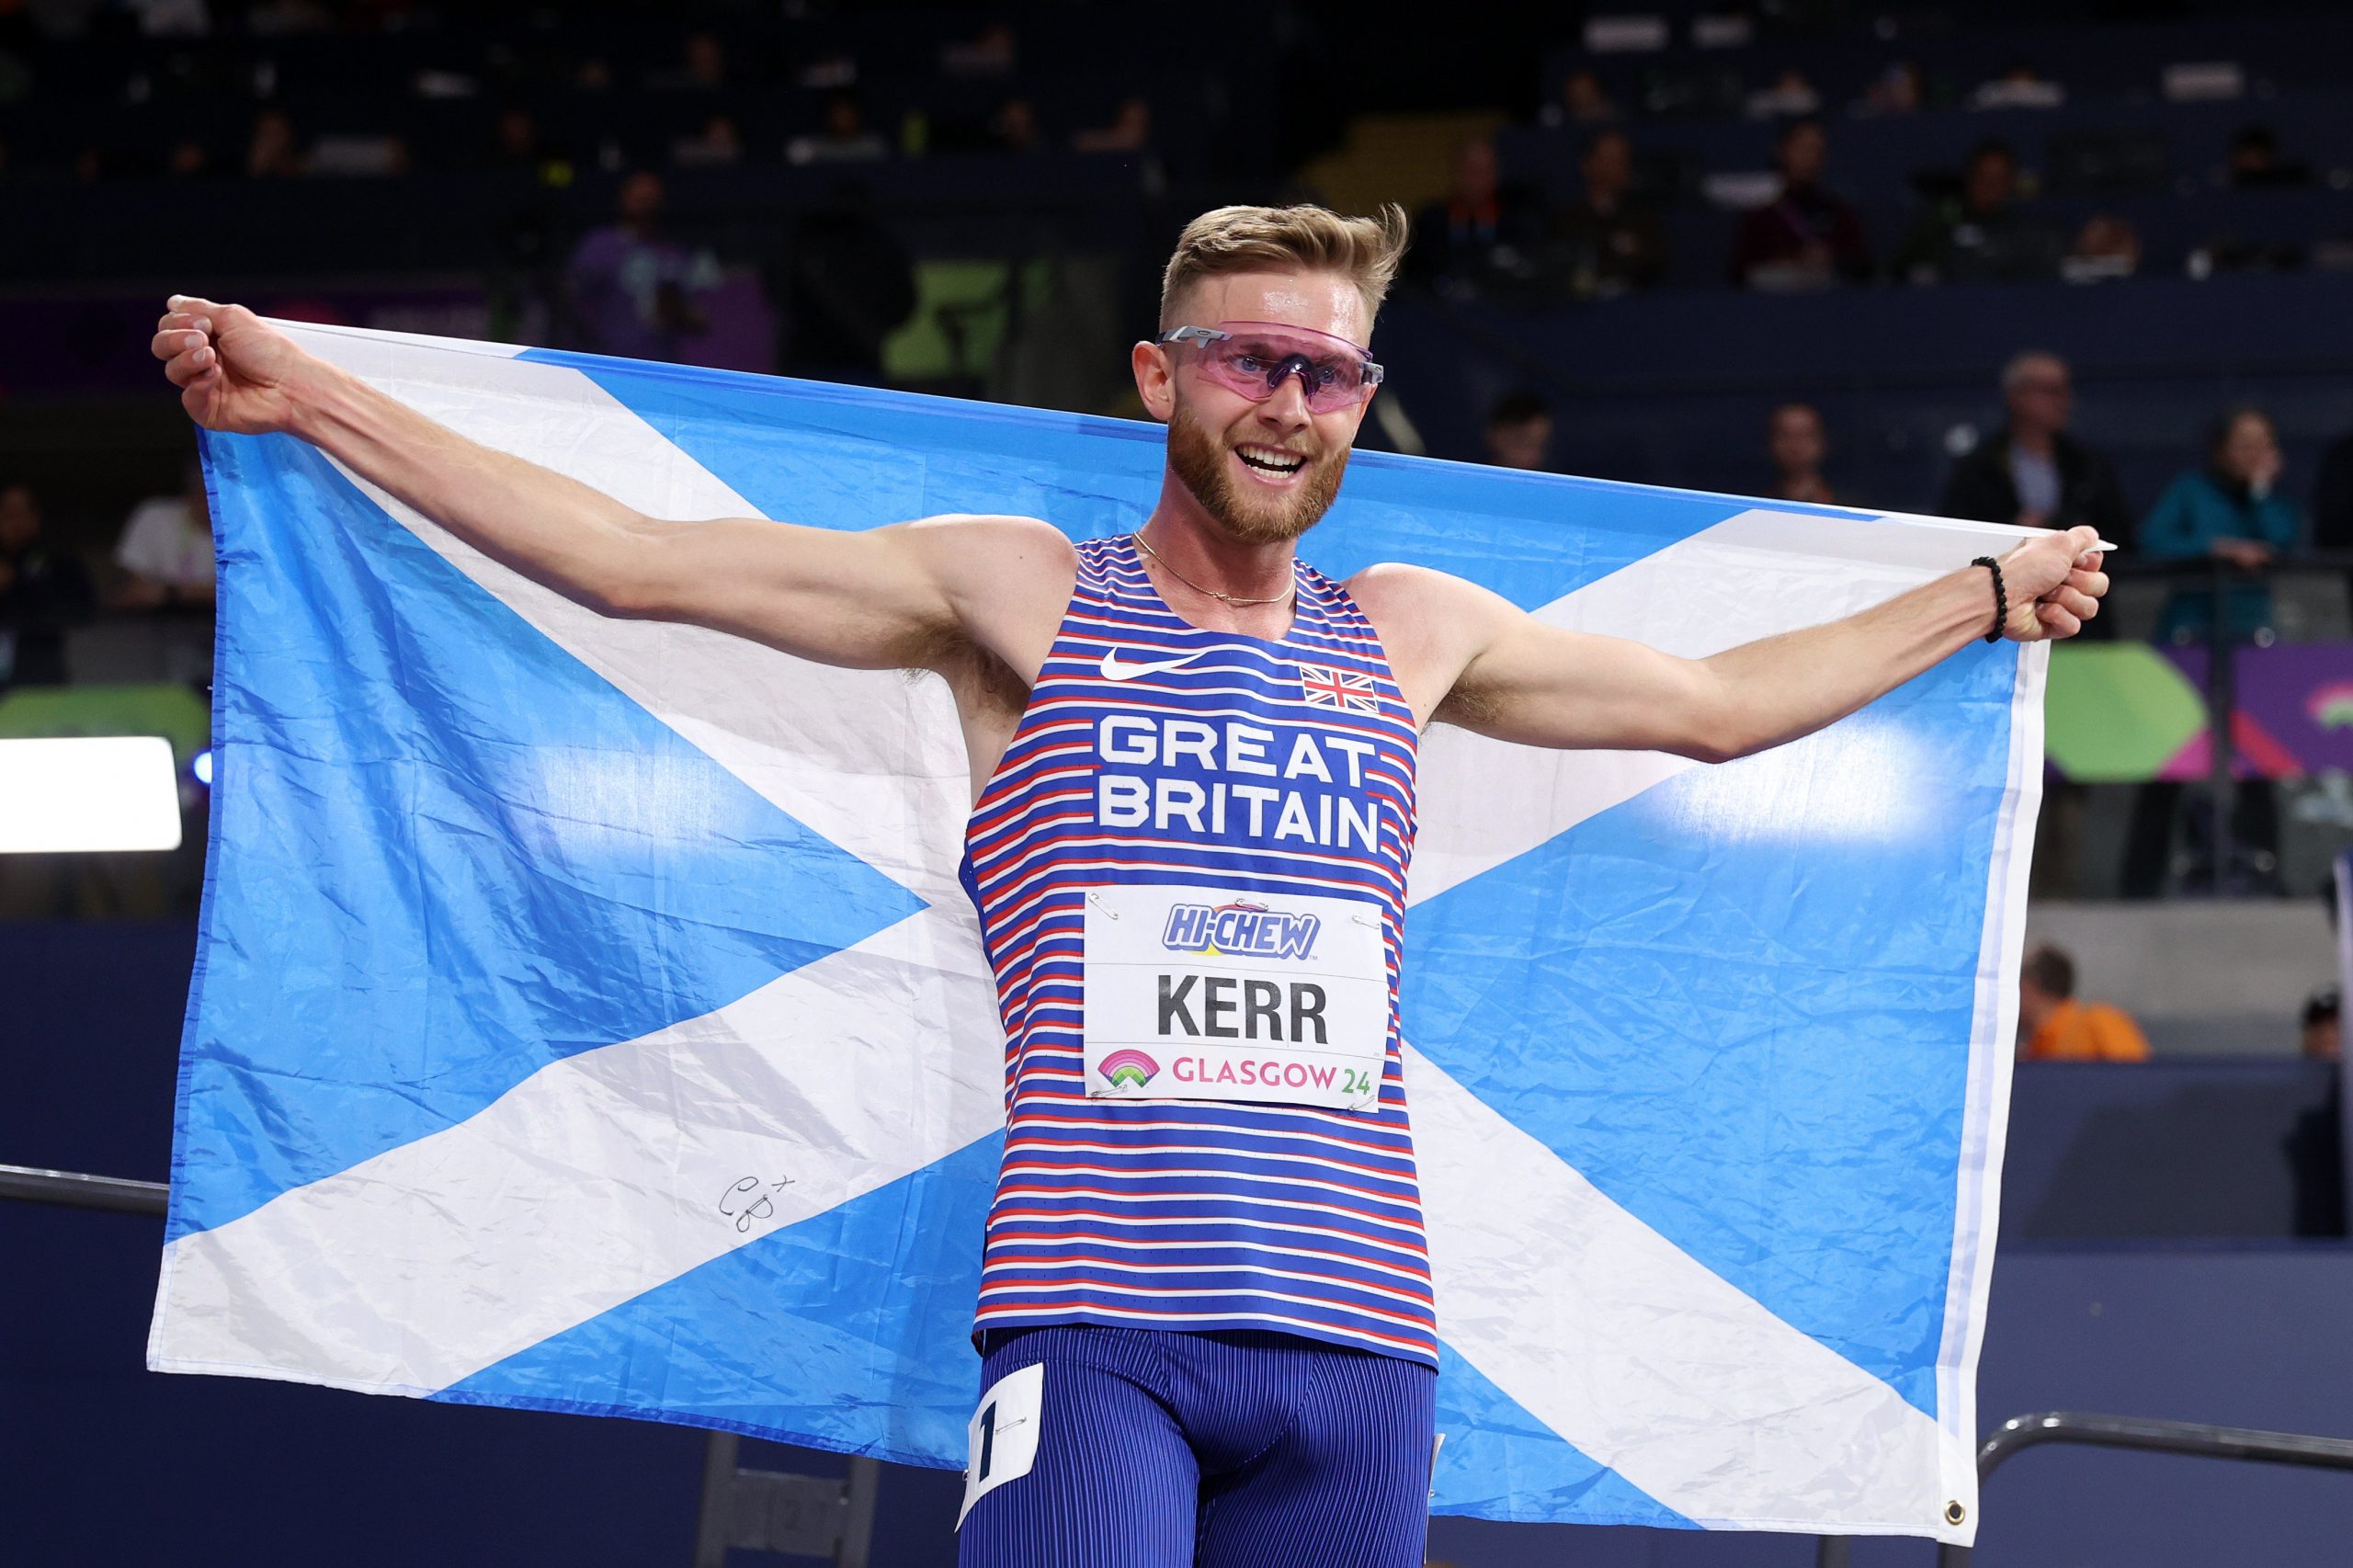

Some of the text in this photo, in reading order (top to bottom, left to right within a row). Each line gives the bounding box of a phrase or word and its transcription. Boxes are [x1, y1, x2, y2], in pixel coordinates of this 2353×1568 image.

[1099, 714, 1376, 788] GREAT
[1098, 775, 1378, 855] BRITAIN
[1162, 903, 1321, 960] HI-CHEW
[1157, 974, 1329, 1045] KERR
[1173, 1057, 1370, 1096] GLASGOW 24
[979, 1399, 997, 1483] 1
